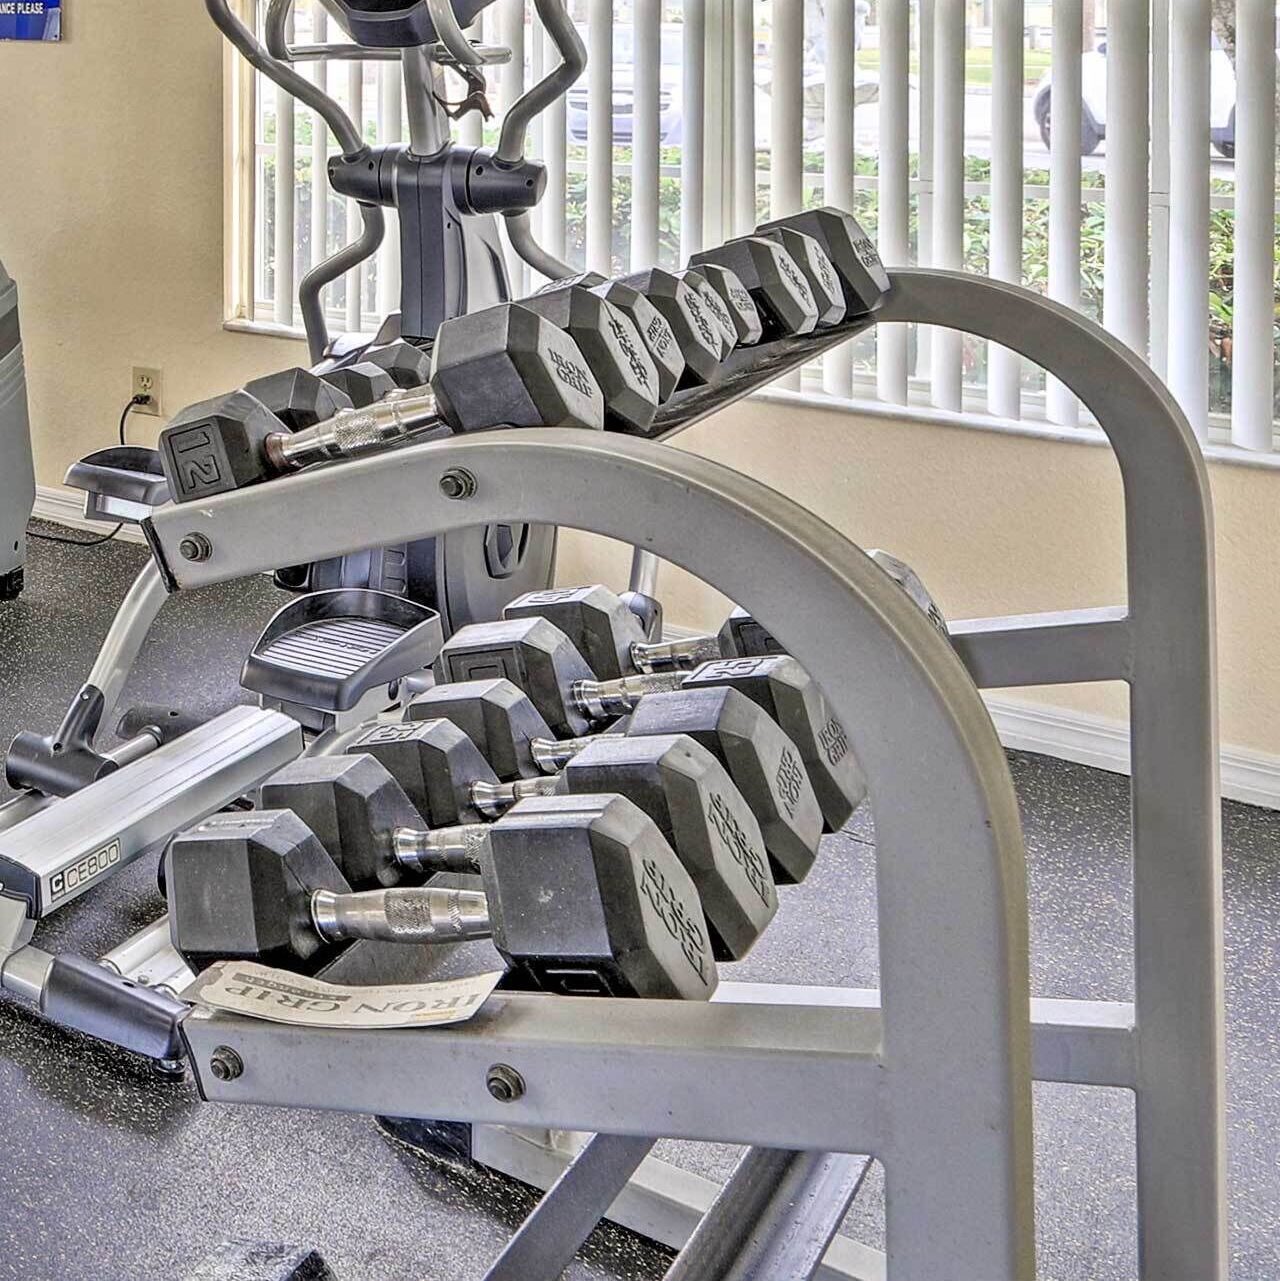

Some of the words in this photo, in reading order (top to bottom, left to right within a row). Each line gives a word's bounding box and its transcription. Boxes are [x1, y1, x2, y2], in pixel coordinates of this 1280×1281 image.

[17, 3, 43, 14] PLEASE
[547, 347, 590, 386] IRON
[556, 366, 593, 399] GRIP
[176, 429, 221, 491] 12
[66, 844, 119, 888] CE800
[224, 984, 340, 1014] GRIP
[351, 991, 482, 1014] IRON
